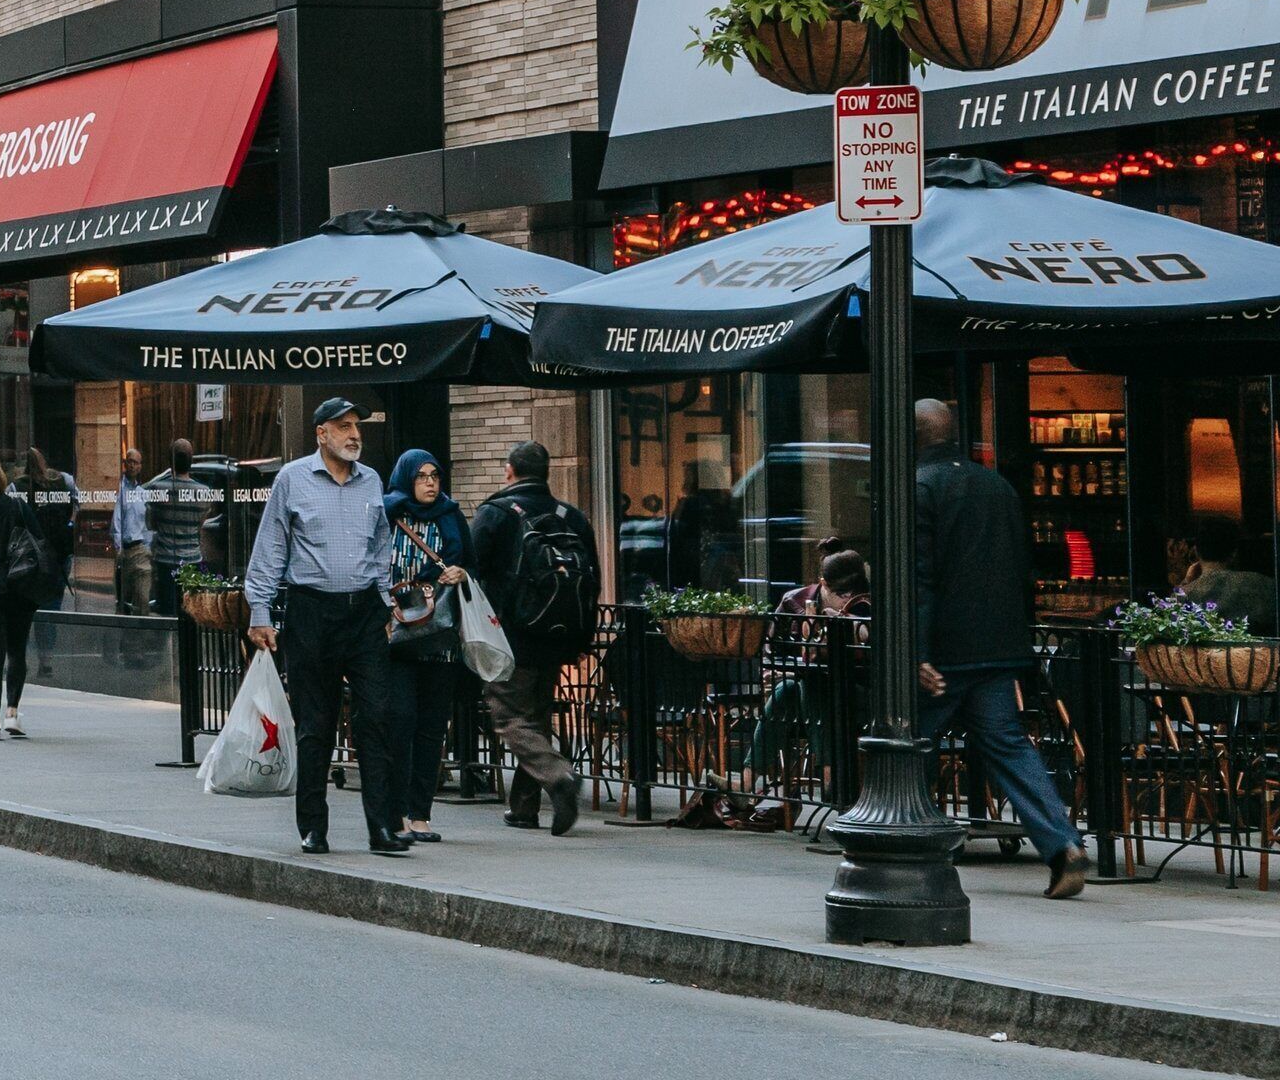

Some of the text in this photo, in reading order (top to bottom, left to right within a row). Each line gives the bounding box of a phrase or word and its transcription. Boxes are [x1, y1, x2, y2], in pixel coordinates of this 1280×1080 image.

[840, 93, 916, 110] TOW ZONE
[958, 59, 1276, 129] THE ITALIAN COFFEE
[863, 122, 893, 139] NO
[842, 142, 916, 156] STOPPING
[864, 160, 894, 172] ANY
[862, 177, 897, 190] TIME
[14, 228, 38, 251] LX
[40, 224, 64, 247] LX
[66, 220, 92, 243] LX
[93, 214, 120, 238] LX
[120, 210, 147, 234] LX
[149, 205, 177, 230] LX
[180, 199, 209, 226] LX
[674, 256, 845, 289] NERO
[966, 253, 1208, 285] NERO
[197, 289, 392, 315] NERO
[605, 324, 771, 353] THE ITALIAN COFFEE
[141, 345, 372, 370] THE ITALIAN COFFEE
[35, 492, 48, 503] LEGAL
[49, 492, 71, 503] CROSSING
[179, 489, 224, 502] LEGAL CROSSING
[234, 489, 251, 502] LEGAL
